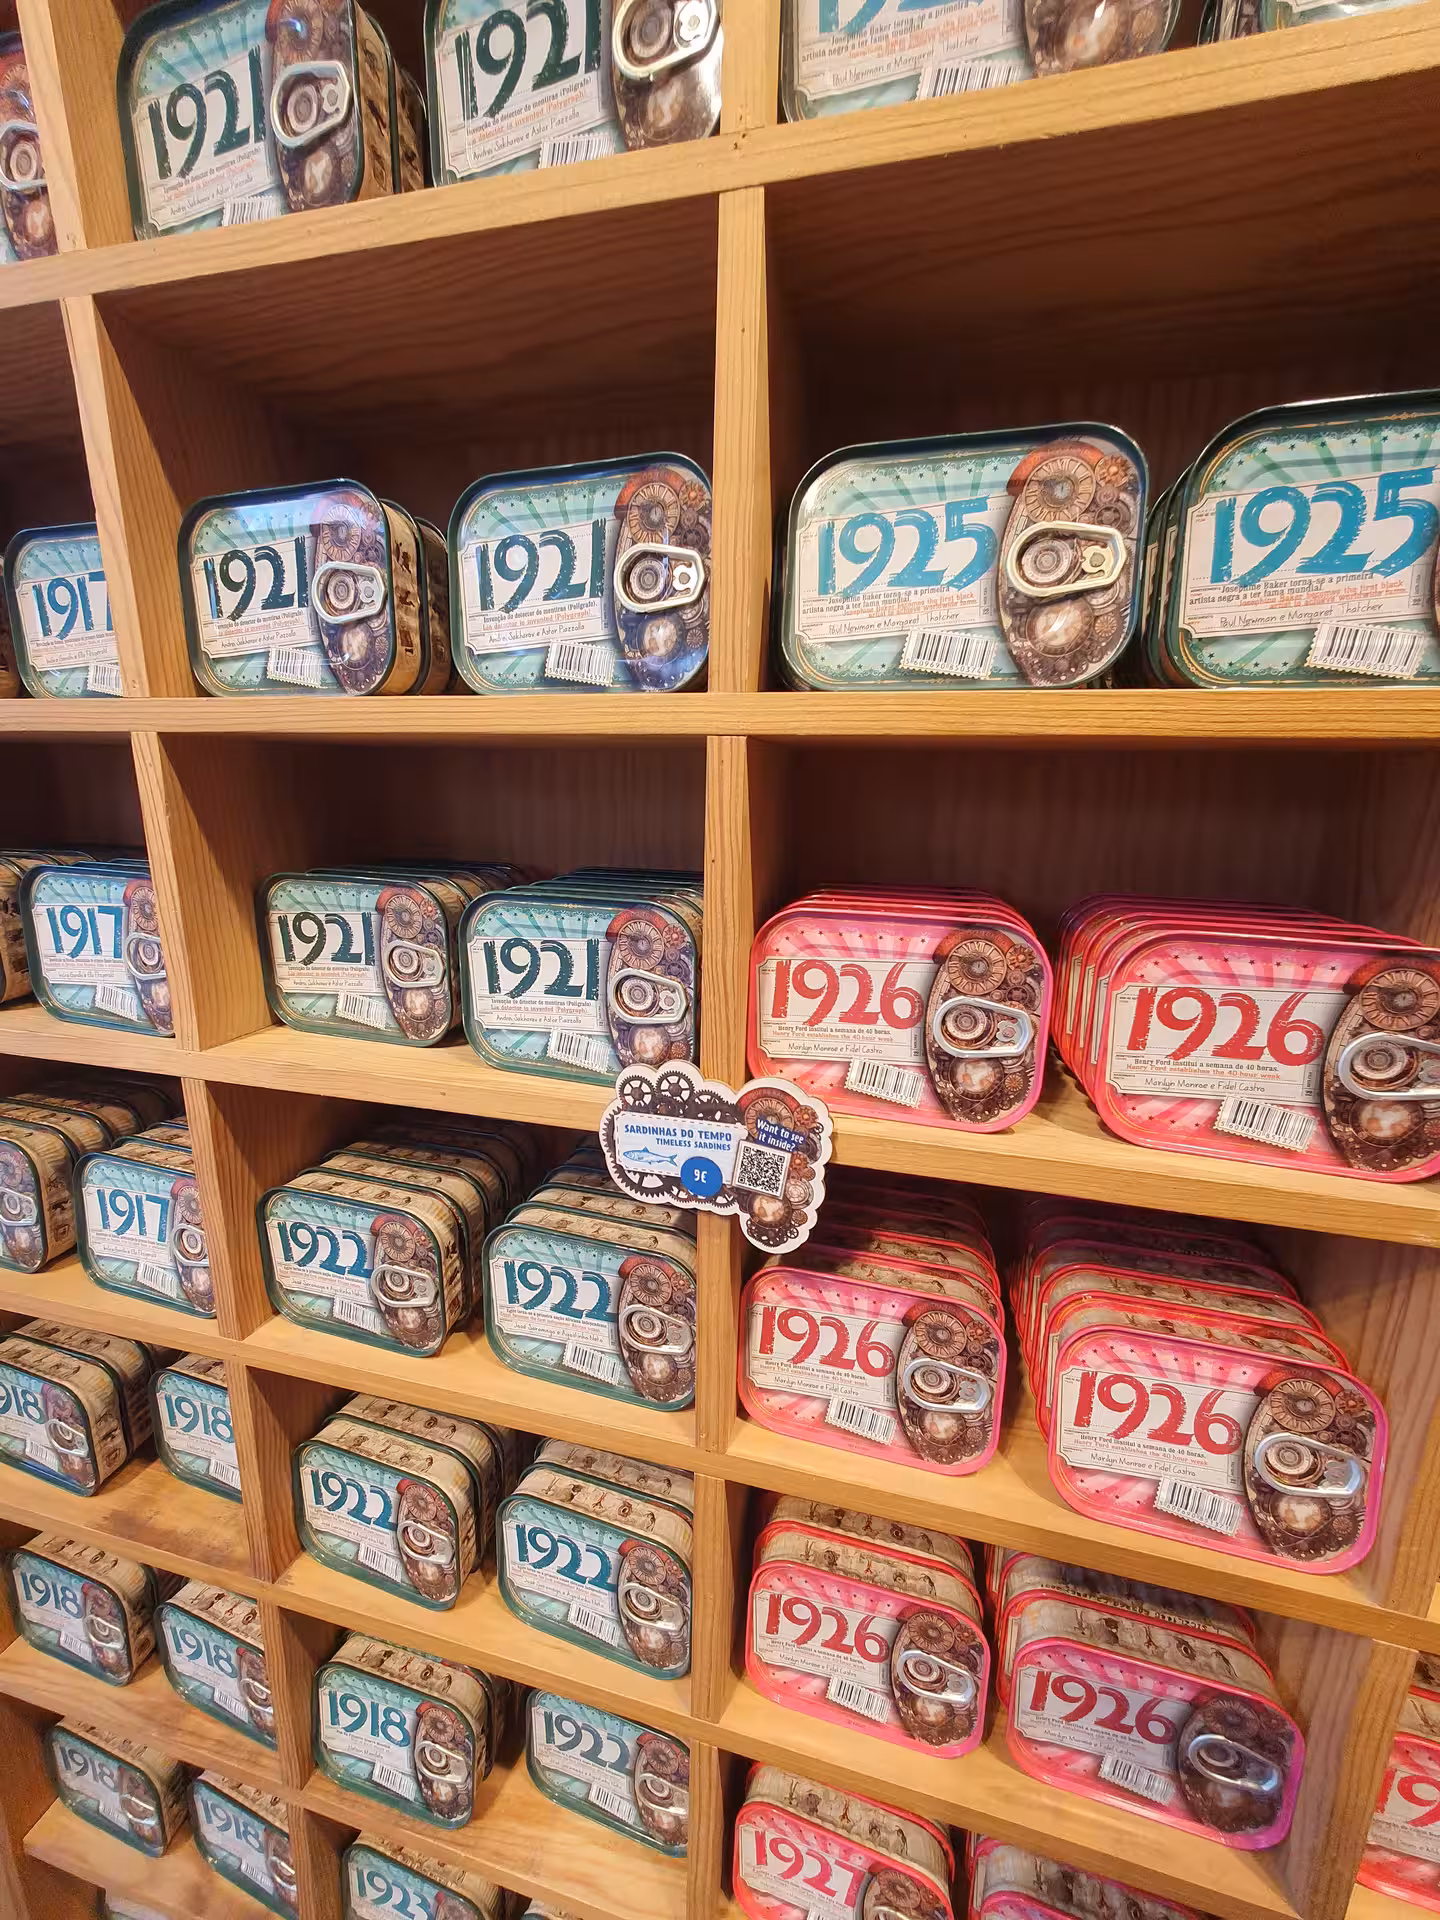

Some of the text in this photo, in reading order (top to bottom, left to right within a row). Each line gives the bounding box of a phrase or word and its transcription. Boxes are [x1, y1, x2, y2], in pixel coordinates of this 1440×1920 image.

[455, 0, 601, 121] 1921
[149, 44, 267, 179] 1921
[818, 494, 998, 598] 1925
[1210, 465, 1440, 586] 1925
[204, 535, 308, 621] 1921
[476, 517, 606, 613] 1921
[1264, 580, 1288, 589] Baker
[1290, 578, 1325, 586] torna-se
[1336, 573, 1373, 584] primeira
[802, 605, 823, 614] artista
[826, 604, 844, 612] negra
[882, 595, 910, 605] mundial
[862, 592, 881, 601] Baker
[920, 586, 950, 596] primeira
[1190, 594, 1215, 605] artista
[1218, 593, 1240, 603] negra
[1264, 588, 1284, 598] fama
[1288, 584, 1322, 594] mundial
[1221, 616, 1236, 627] Paul
[1239, 614, 1276, 627] Newman
[1288, 605, 1333, 623] Margaret
[1342, 600, 1383, 614] Thatcher
[829, 623, 842, 634] Paul
[843, 623, 874, 634] Newman
[884, 617, 920, 630] Margaret
[926, 611, 959, 623] Thatcher
[47, 905, 123, 958] 1917
[278, 912, 375, 966] 1921
[484, 938, 599, 999] 1921
[772, 960, 924, 1029] 1926
[788, 1043, 812, 1054] Marilyn
[862, 1046, 882, 1054] Castro
[1127, 987, 1325, 1066] 1926
[1145, 1078, 1175, 1091] Marilyn
[1177, 1080, 1208, 1088] Monroe
[1218, 1081, 1237, 1090] Fidel
[1239, 1083, 1265, 1092] Castro
[625, 1125, 732, 1141] SARDINHAS DO TEMPO
[656, 1138, 731, 1150] TIMELESS SARDINES
[757, 1119, 804, 1144] Want to see
[768, 1136, 796, 1152] inside?
[694, 1169, 707, 1183] 9€
[97, 1189, 169, 1242] 1917
[278, 1221, 373, 1278] 1922
[504, 1261, 618, 1322] 1922
[759, 1306, 895, 1377] 1926
[0, 1382, 45, 1424] 918
[164, 1394, 234, 1443] 1918
[1074, 1371, 1242, 1455] 1926
[1080, 1434, 1097, 1442] Henry
[1114, 1438, 1135, 1447] institui
[1142, 1443, 1166, 1453] semana
[1091, 1453, 1117, 1467] Marilyn
[1119, 1457, 1146, 1468] Monroe
[1155, 1462, 1171, 1473] Fidel
[1173, 1465, 1195, 1477] Castro
[311, 1469, 398, 1531] 1922
[516, 1524, 617, 1592] 1922
[21, 1572, 83, 1619] 1918
[170, 1625, 239, 1678] 1918
[766, 1594, 889, 1663] 1926
[329, 1691, 411, 1747] 1918
[1029, 1671, 1176, 1745] 1926
[60, 1746, 117, 1793] 1918
[544, 1711, 635, 1775] 1922
[1376, 1768, 1440, 1827] 19
[202, 1799, 265, 1854] 1918
[755, 1831, 865, 1908] 1927
